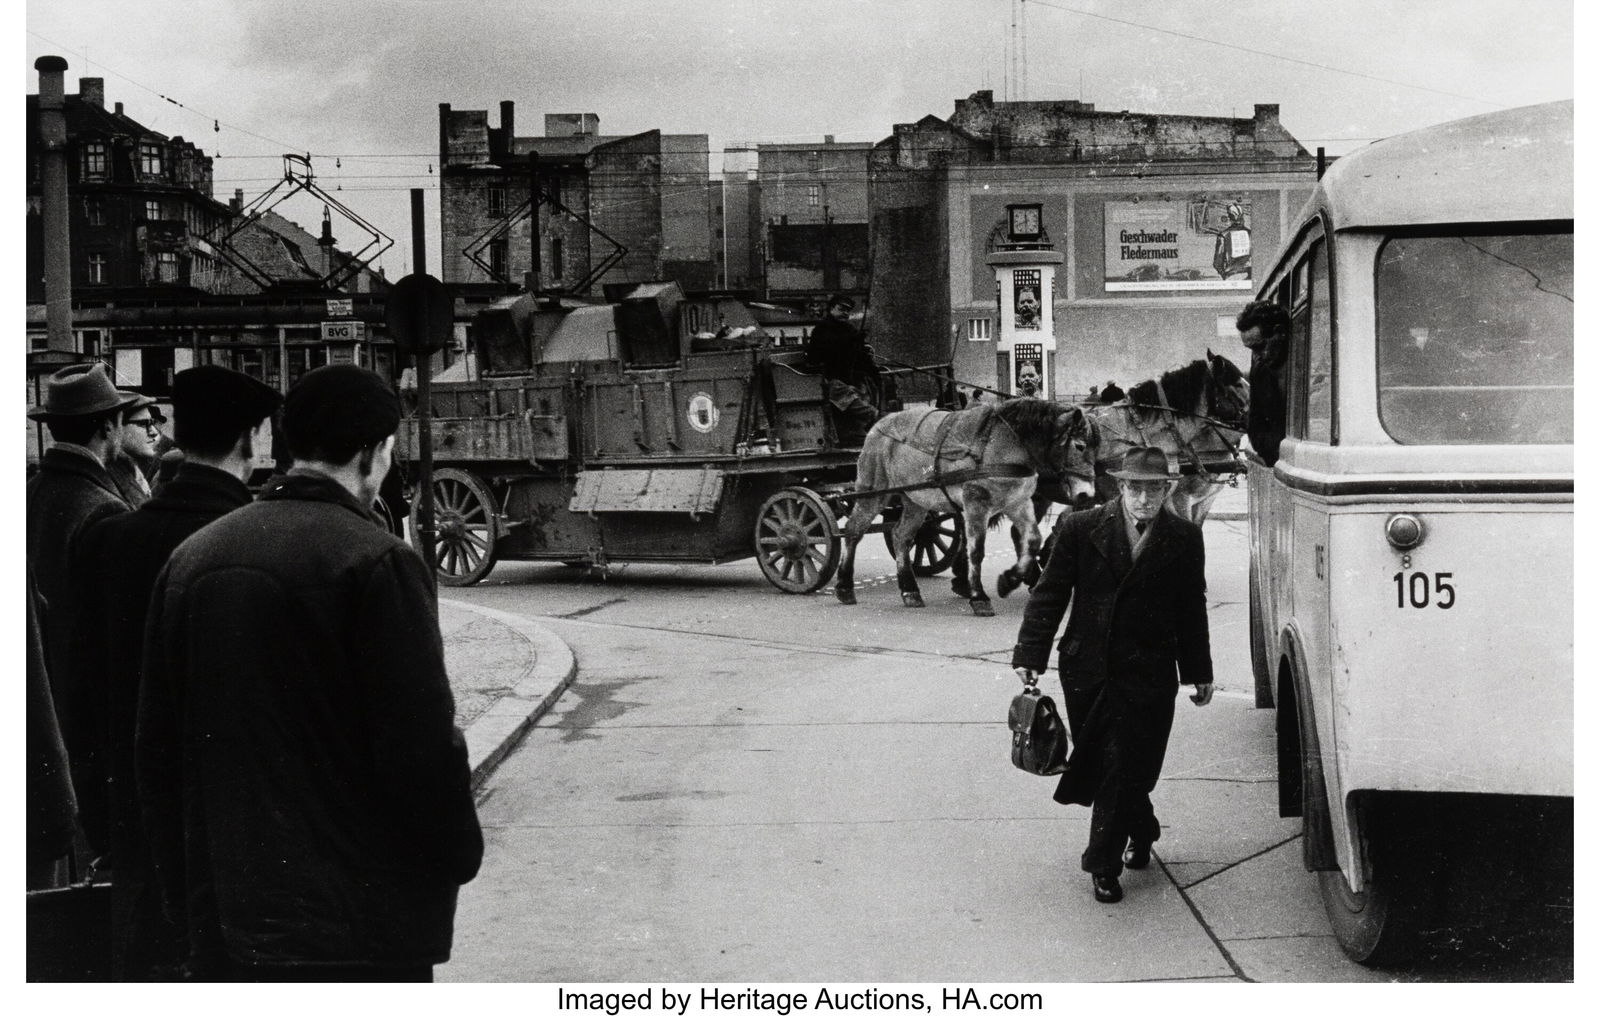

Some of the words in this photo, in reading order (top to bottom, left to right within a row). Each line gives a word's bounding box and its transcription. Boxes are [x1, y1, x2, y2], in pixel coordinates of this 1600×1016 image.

[1120, 229, 1178, 243] Geschwader
[1120, 246, 1179, 260] Fledermaus
[328, 327, 348, 337] BVG
[1393, 572, 1456, 609] 105
